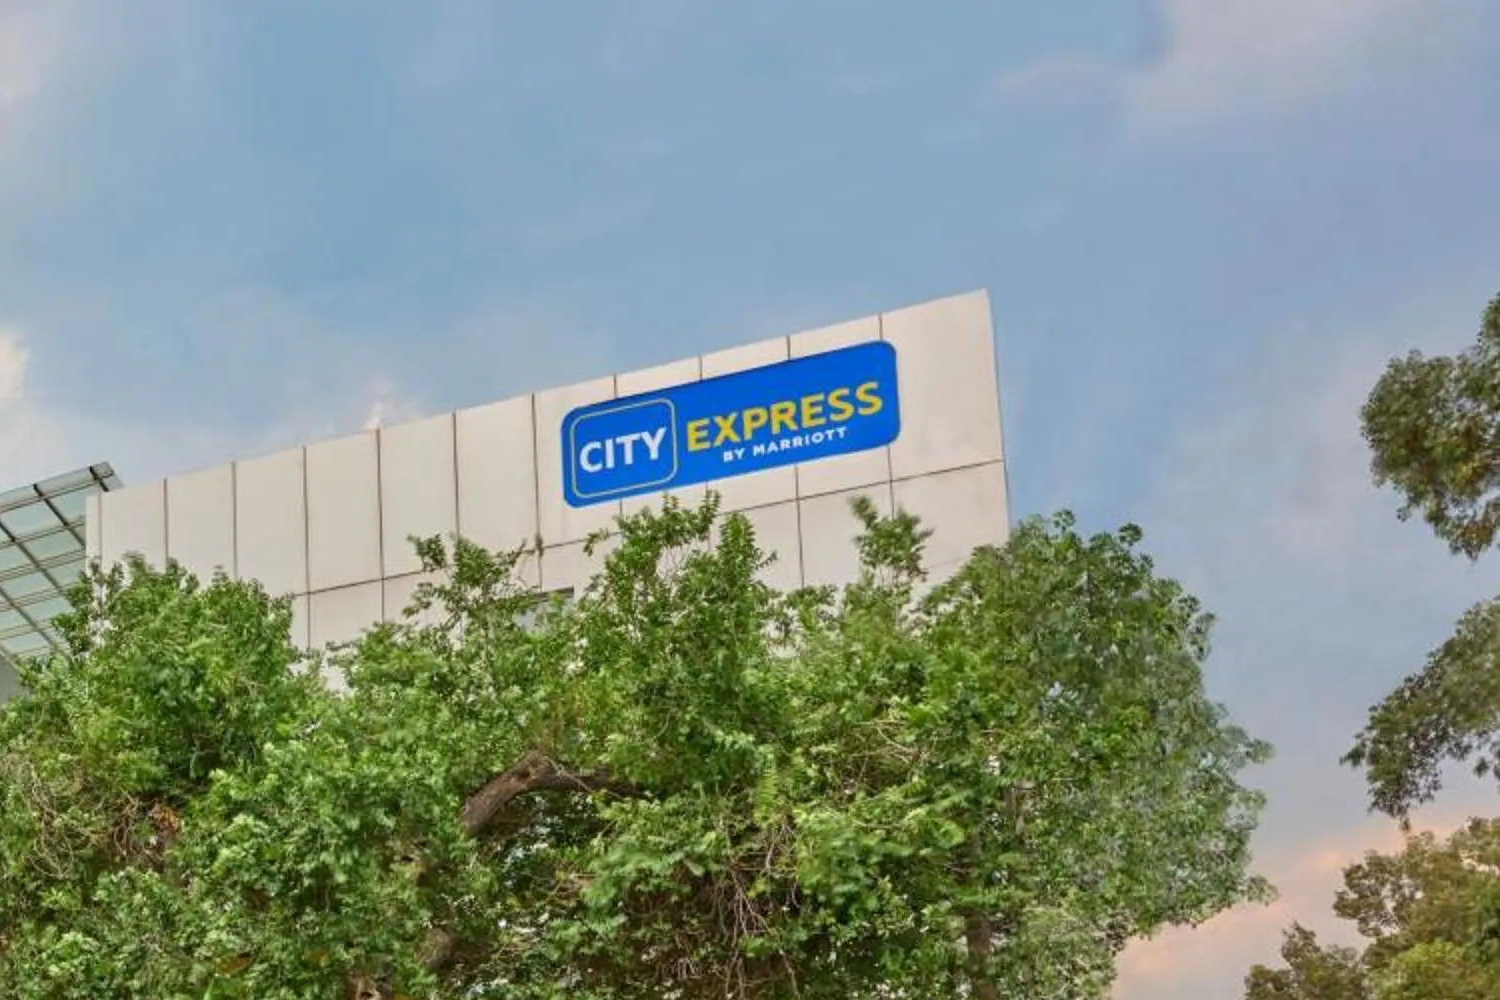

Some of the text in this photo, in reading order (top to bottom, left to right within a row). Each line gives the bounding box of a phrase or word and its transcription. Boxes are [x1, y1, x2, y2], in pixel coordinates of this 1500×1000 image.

[579, 381, 884, 473] CITY EXPRESS
[723, 427, 848, 463] BY MARRIOTT
